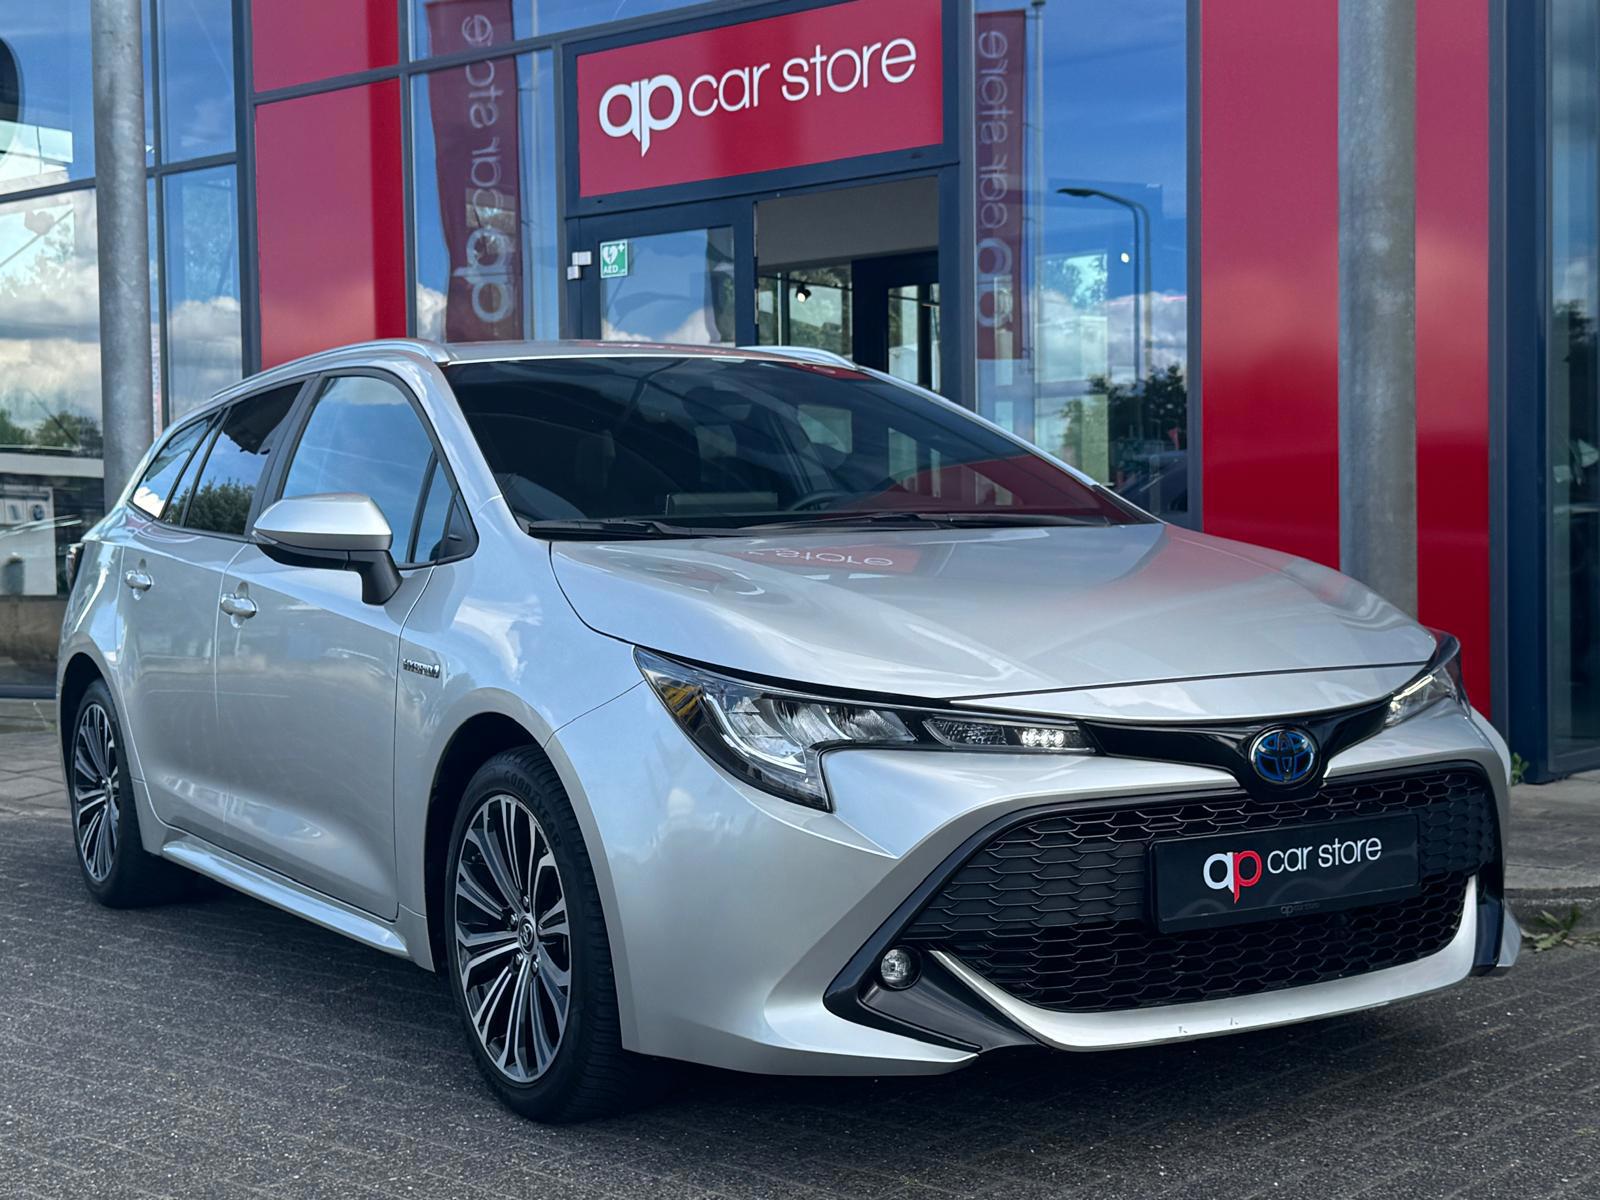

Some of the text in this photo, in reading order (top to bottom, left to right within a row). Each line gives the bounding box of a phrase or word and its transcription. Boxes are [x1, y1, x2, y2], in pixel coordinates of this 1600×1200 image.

[599, 38, 917, 157] ap car store
[603, 264, 619, 274] AED
[1203, 837, 1382, 904] ap car store
